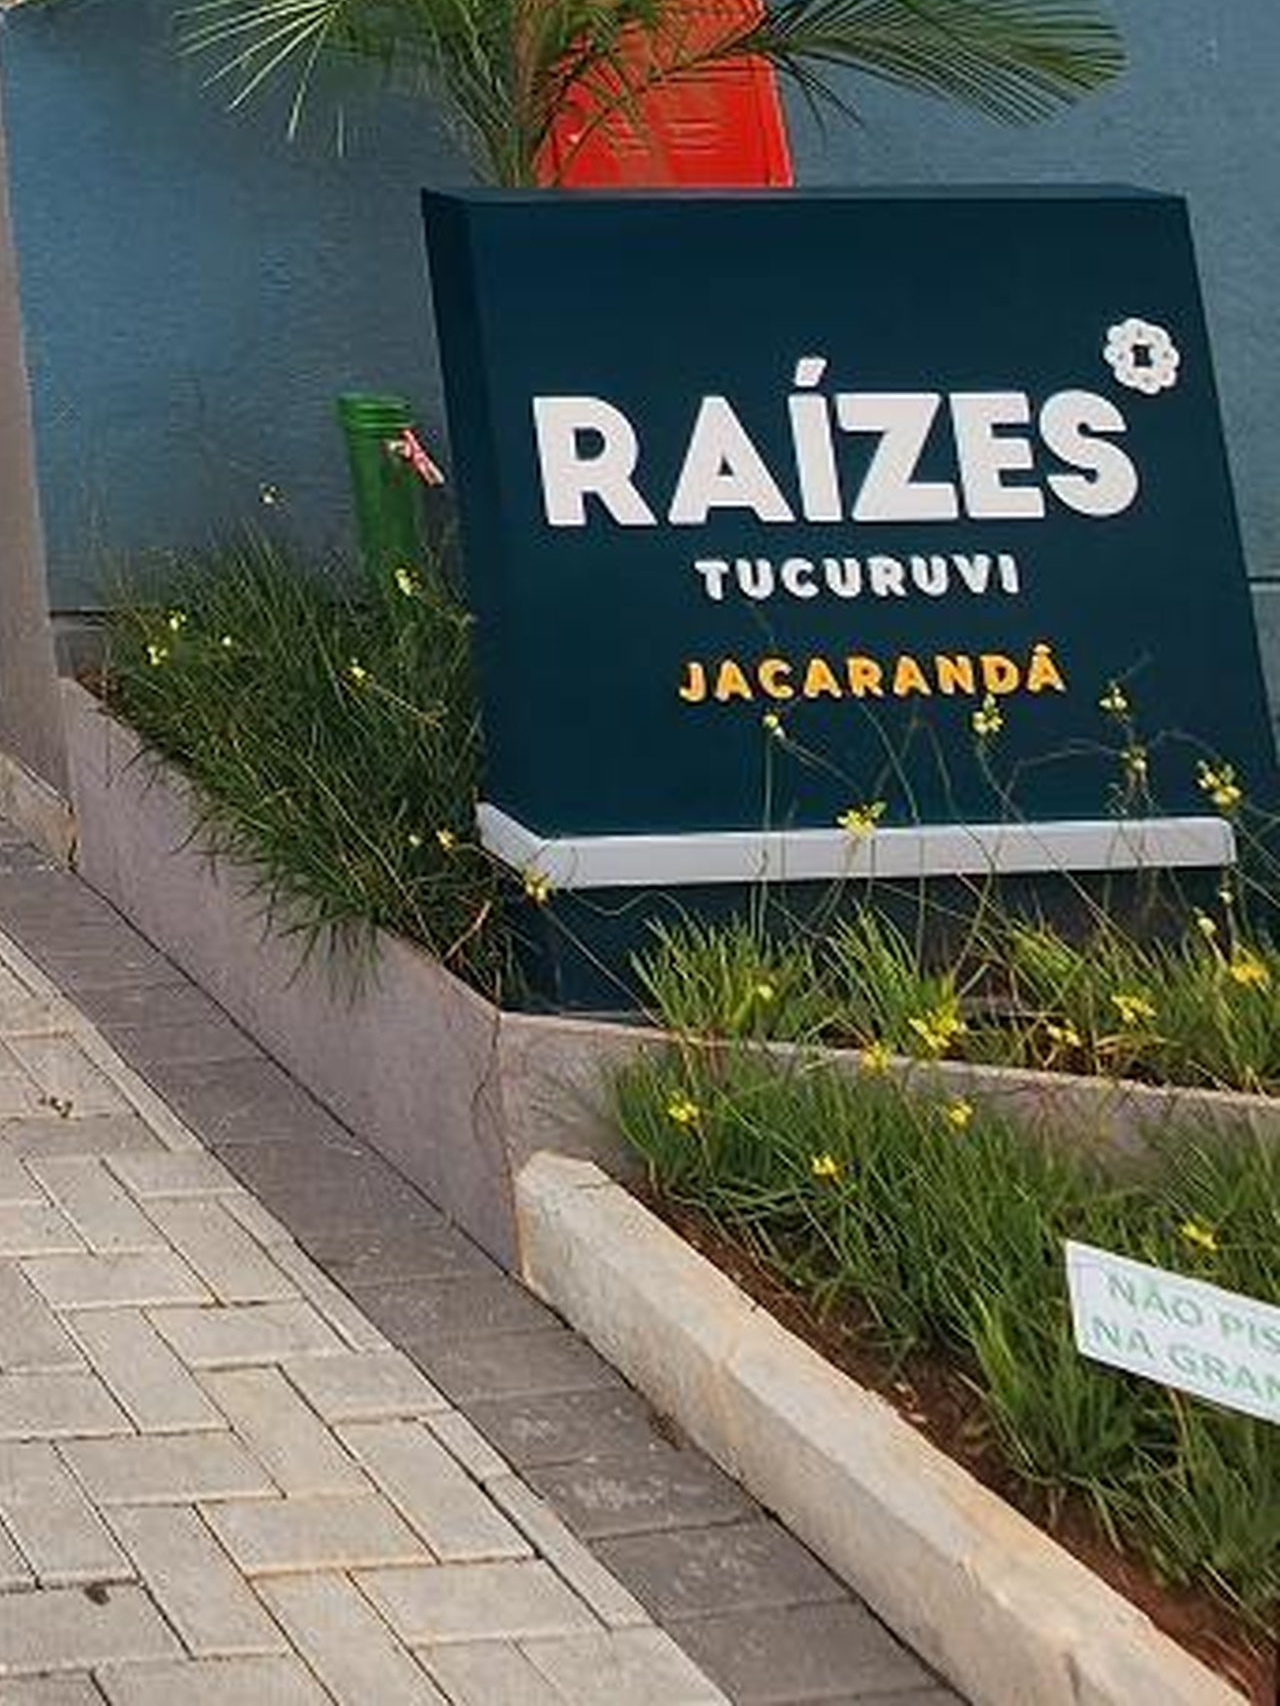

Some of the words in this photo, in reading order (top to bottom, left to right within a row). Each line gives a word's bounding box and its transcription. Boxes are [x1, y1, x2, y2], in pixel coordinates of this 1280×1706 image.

[531, 356, 1139, 527] RAÍZES
[694, 553, 1021, 601] TUCURUVI
[678, 642, 1066, 703] JACARANDÁ
[1105, 1272, 1202, 1328] NÃO
[1093, 1316, 1154, 1360] NA
